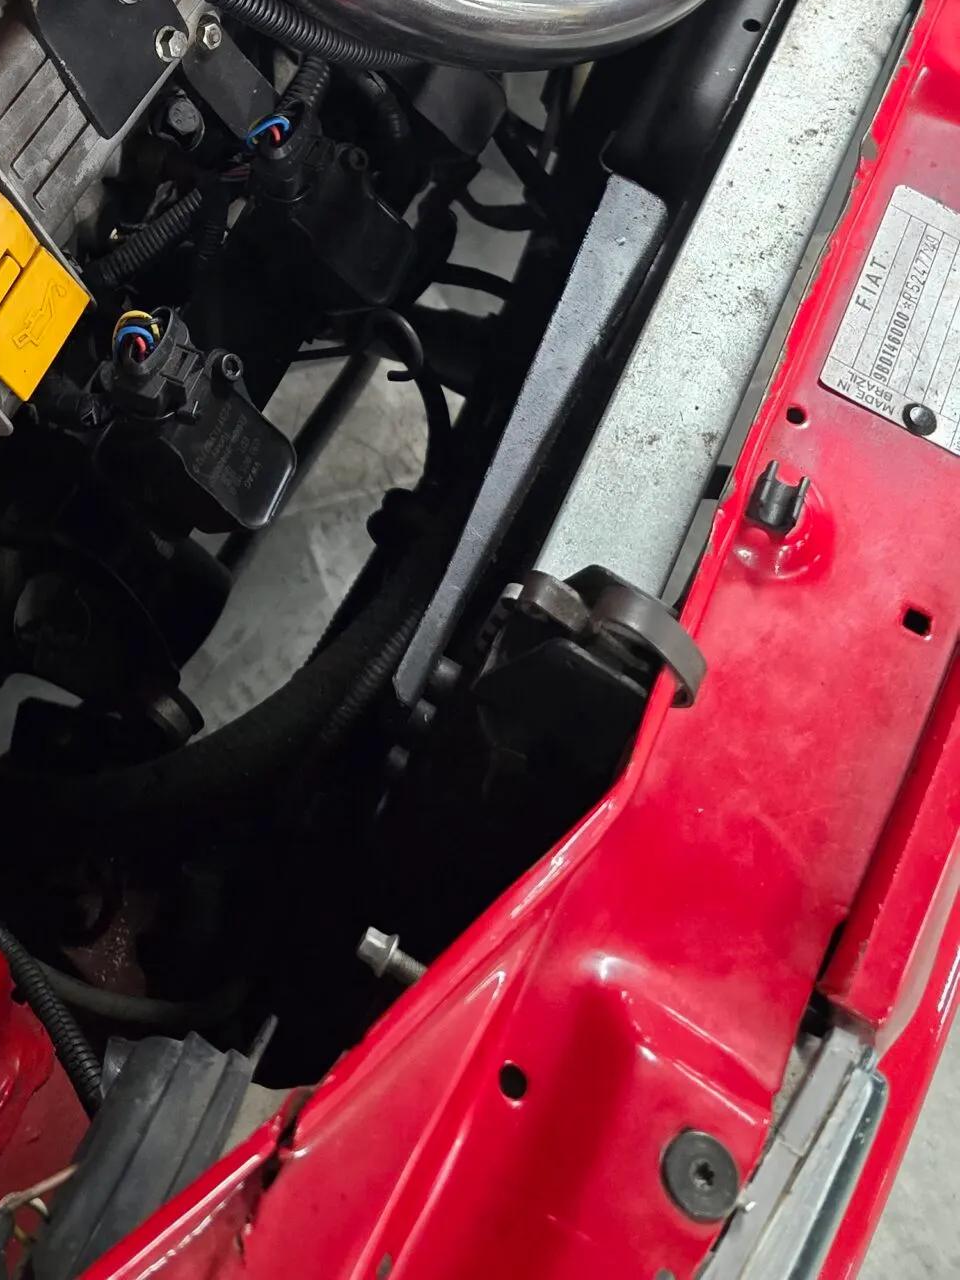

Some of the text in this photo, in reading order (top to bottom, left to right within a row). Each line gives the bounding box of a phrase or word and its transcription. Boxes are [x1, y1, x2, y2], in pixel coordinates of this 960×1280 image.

[855, 255, 888, 312] FIAT
[836, 379, 895, 416] MADE IN
[847, 370, 893, 402] BRAZIL
